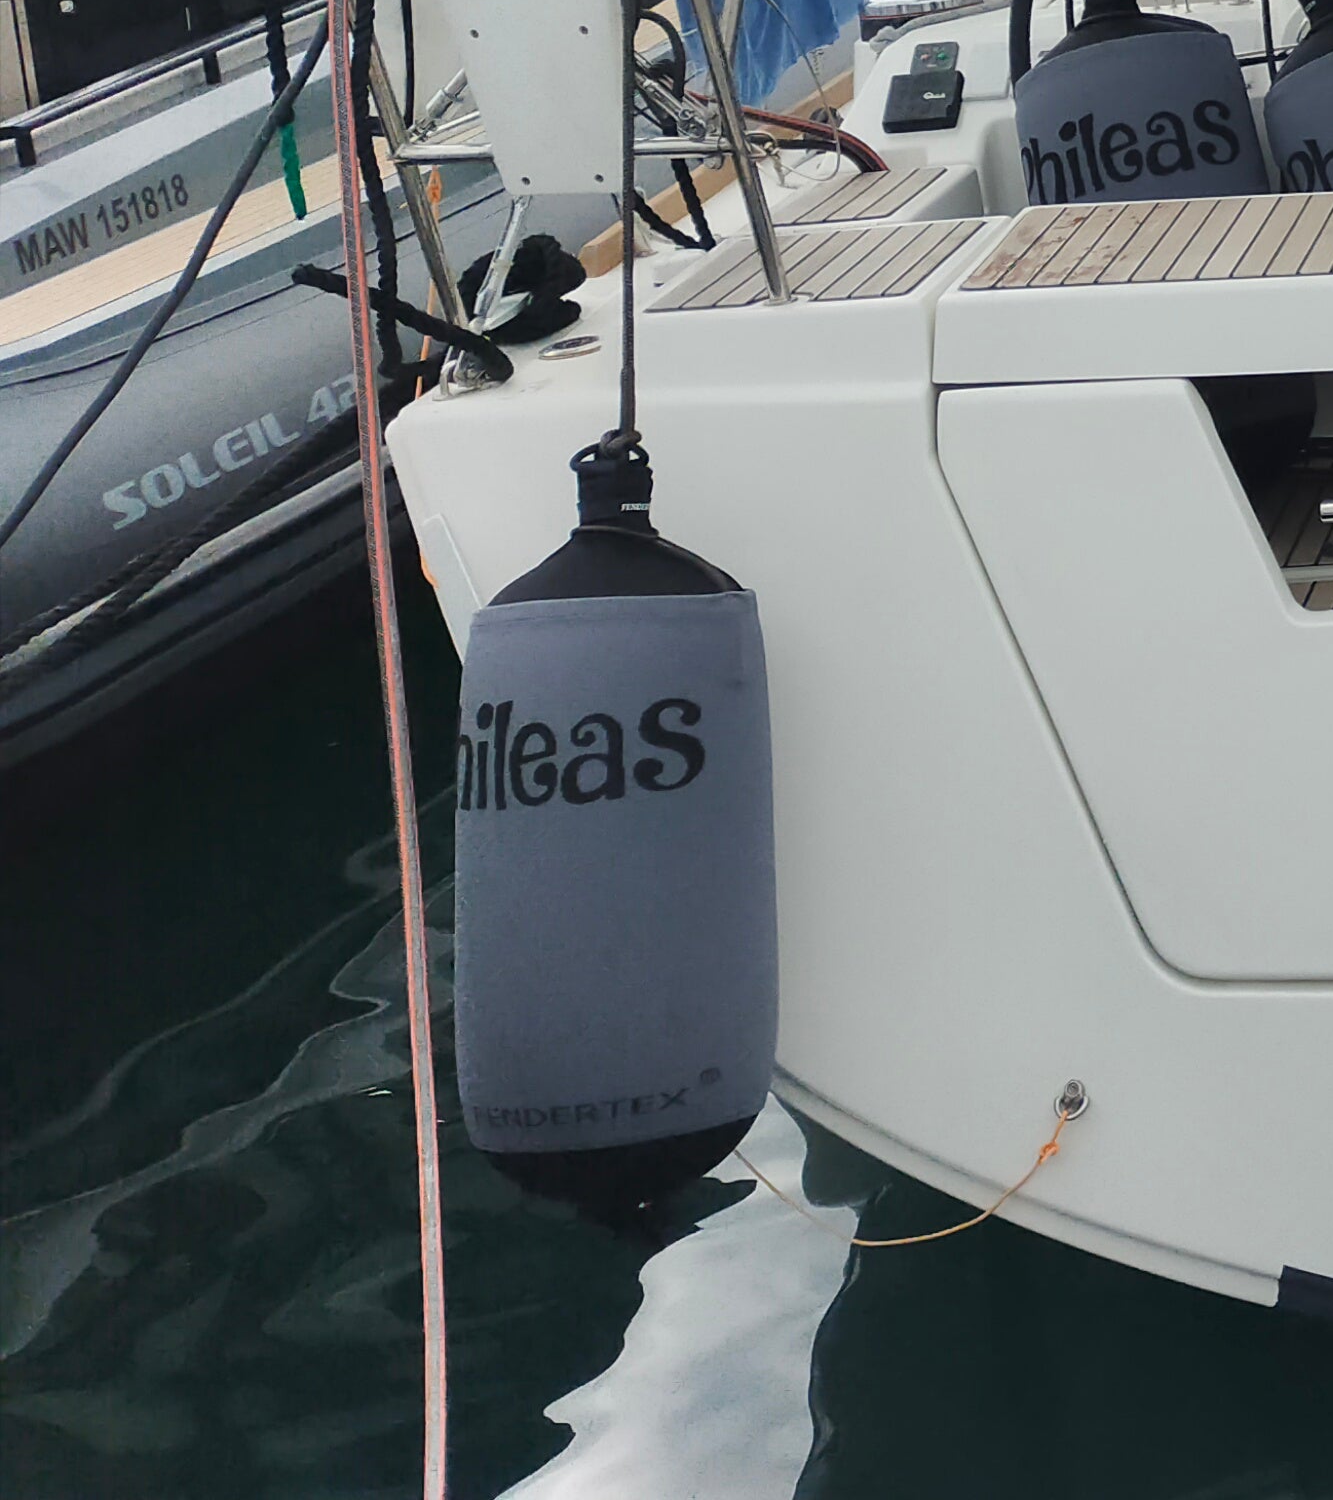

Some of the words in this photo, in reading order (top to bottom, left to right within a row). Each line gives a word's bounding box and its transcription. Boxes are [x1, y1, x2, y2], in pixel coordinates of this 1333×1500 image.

[13, 212, 91, 276] MAW
[97, 173, 190, 239] 151818
[102, 412, 301, 531] SOLEIL
[455, 697, 706, 812] hileas
